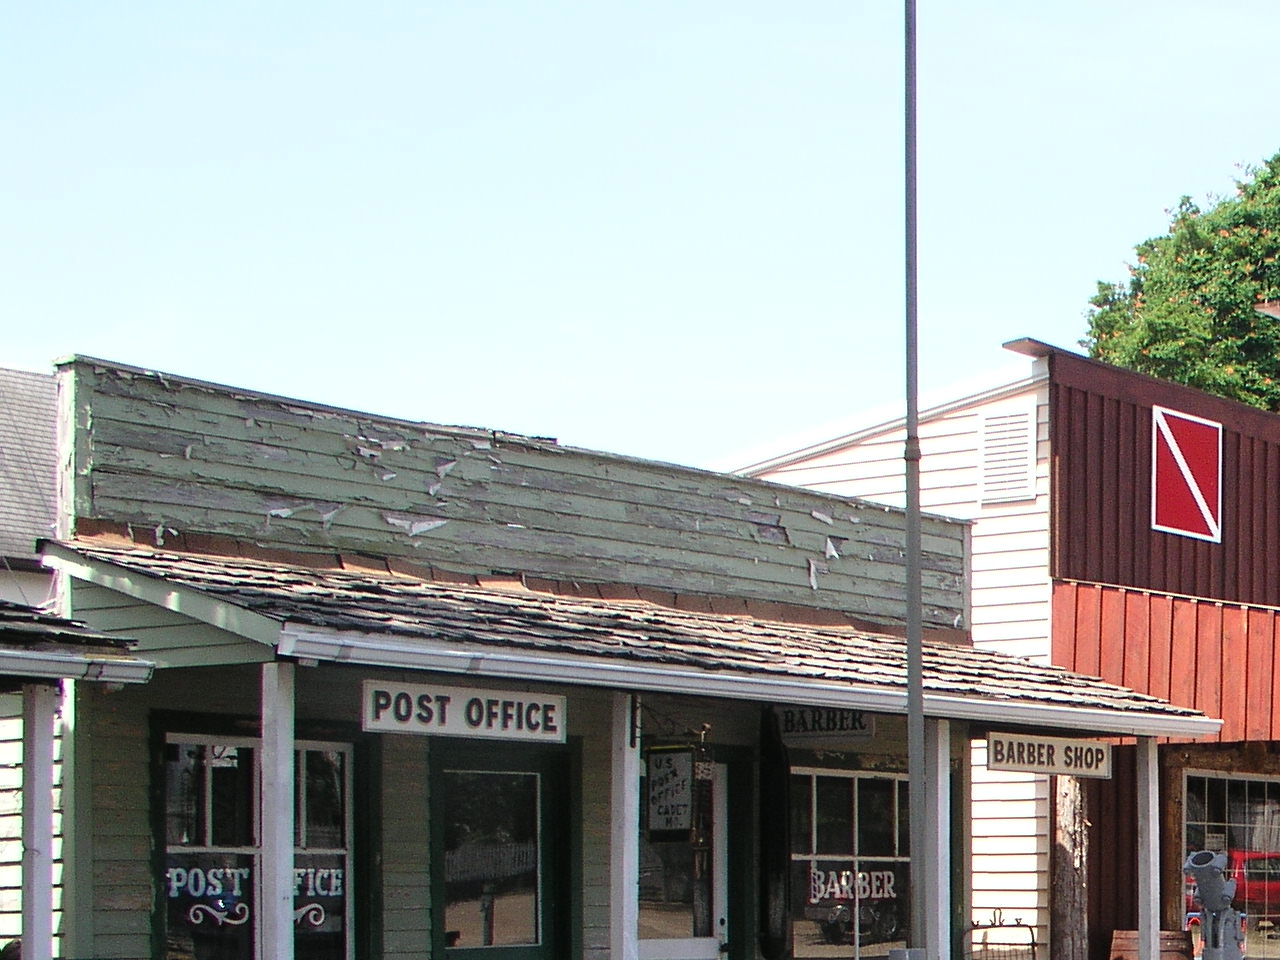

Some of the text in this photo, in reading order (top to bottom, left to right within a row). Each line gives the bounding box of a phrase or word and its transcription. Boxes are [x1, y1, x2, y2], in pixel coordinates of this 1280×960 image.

[372, 689, 558, 732] POST OFFICE
[783, 710, 867, 732] BARBER
[993, 740, 1105, 769] BARBER SHOP
[169, 868, 249, 897] POST
[814, 870, 897, 899] BARBER
